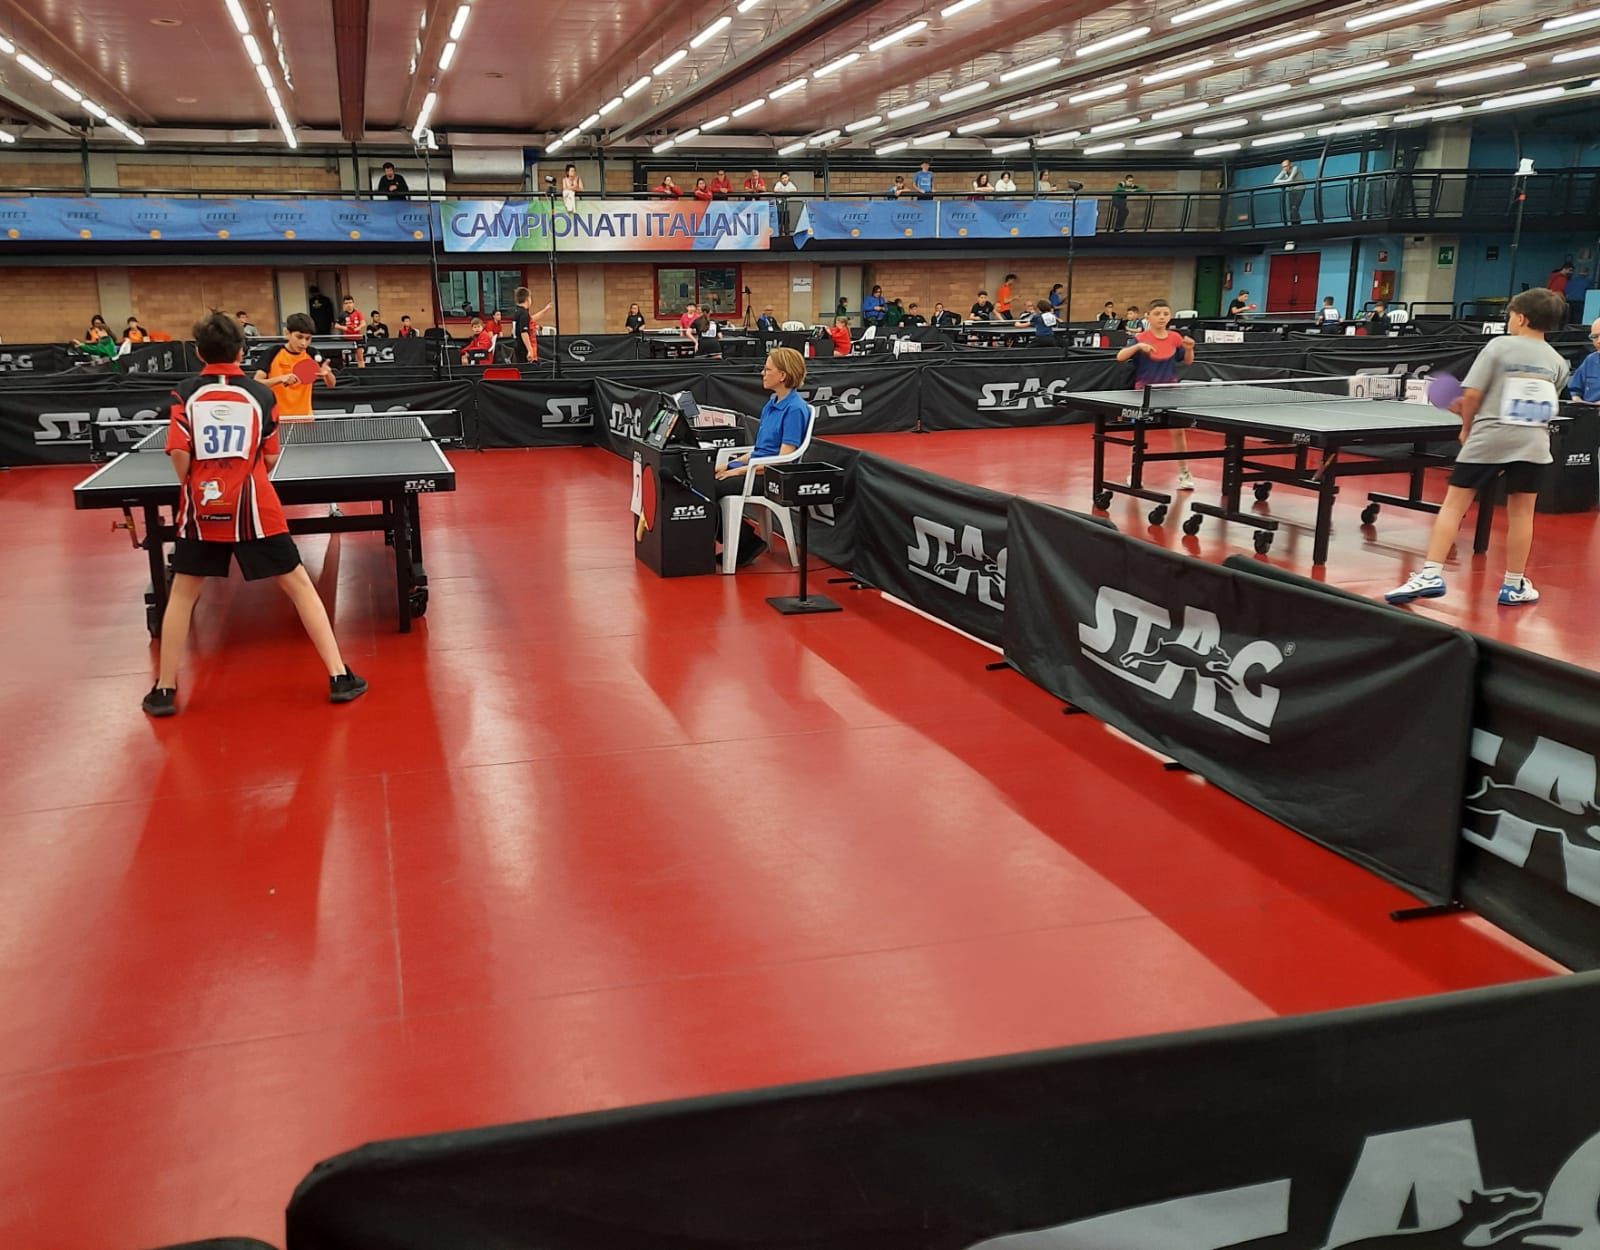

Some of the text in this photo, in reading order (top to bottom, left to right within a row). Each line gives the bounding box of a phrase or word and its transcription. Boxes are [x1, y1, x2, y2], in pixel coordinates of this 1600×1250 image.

[451, 213, 759, 237] CAMPIONATI ITALIANI
[34, 407, 160, 444] STAG
[609, 403, 644, 441] STAG
[203, 425, 246, 454] 377
[404, 479, 436, 490] STAG
[798, 483, 831, 495] STAG
[672, 505, 705, 517] STAG
[907, 516, 1005, 611] STA
[1078, 586, 1283, 744] STAG
